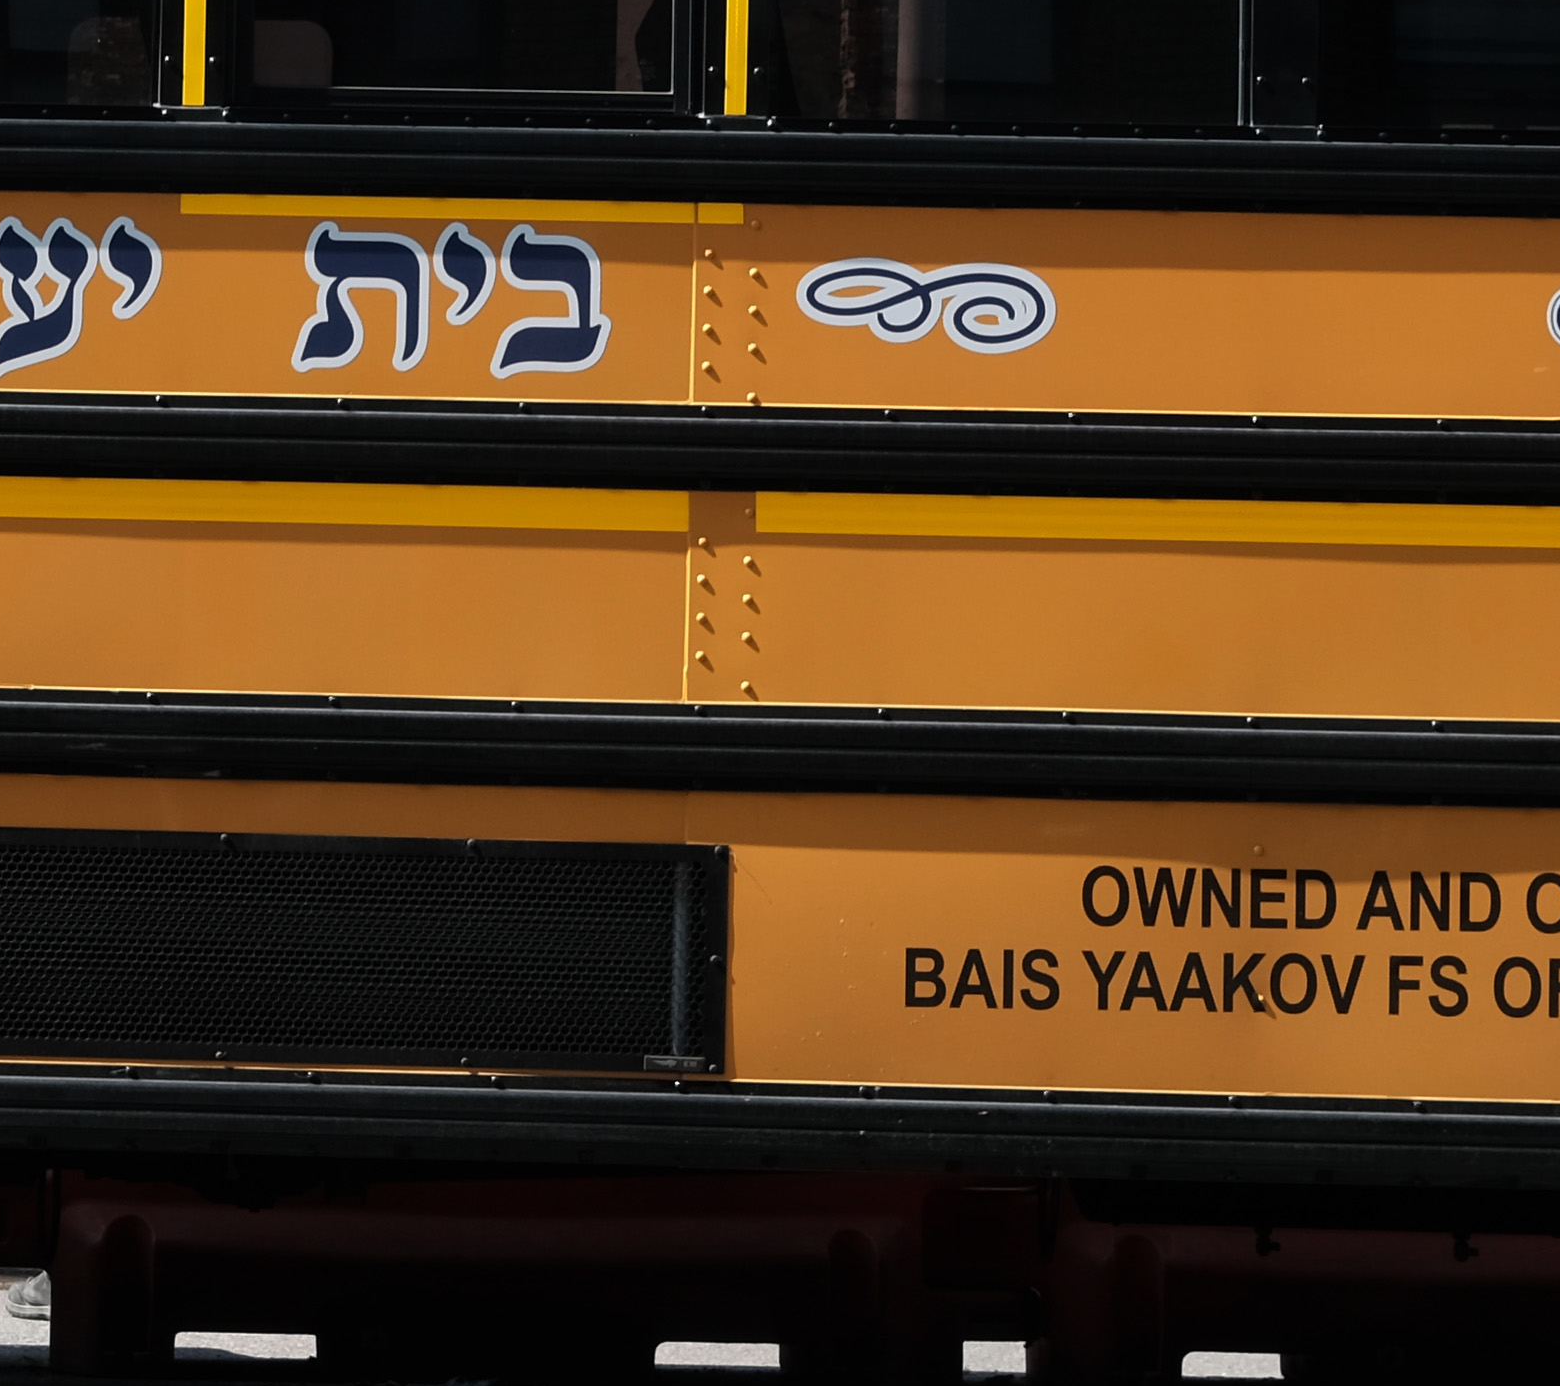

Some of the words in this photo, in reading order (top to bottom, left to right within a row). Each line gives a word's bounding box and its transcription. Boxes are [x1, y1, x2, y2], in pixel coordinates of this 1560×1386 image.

[291, 219, 612, 379] בית
[1082, 865, 1337, 930] OWNED
[1356, 869, 1502, 933] AND
[904, 947, 1060, 1011] BAIS
[1081, 950, 1366, 1015] YAAKOV
[1388, 955, 1469, 1018] FS
